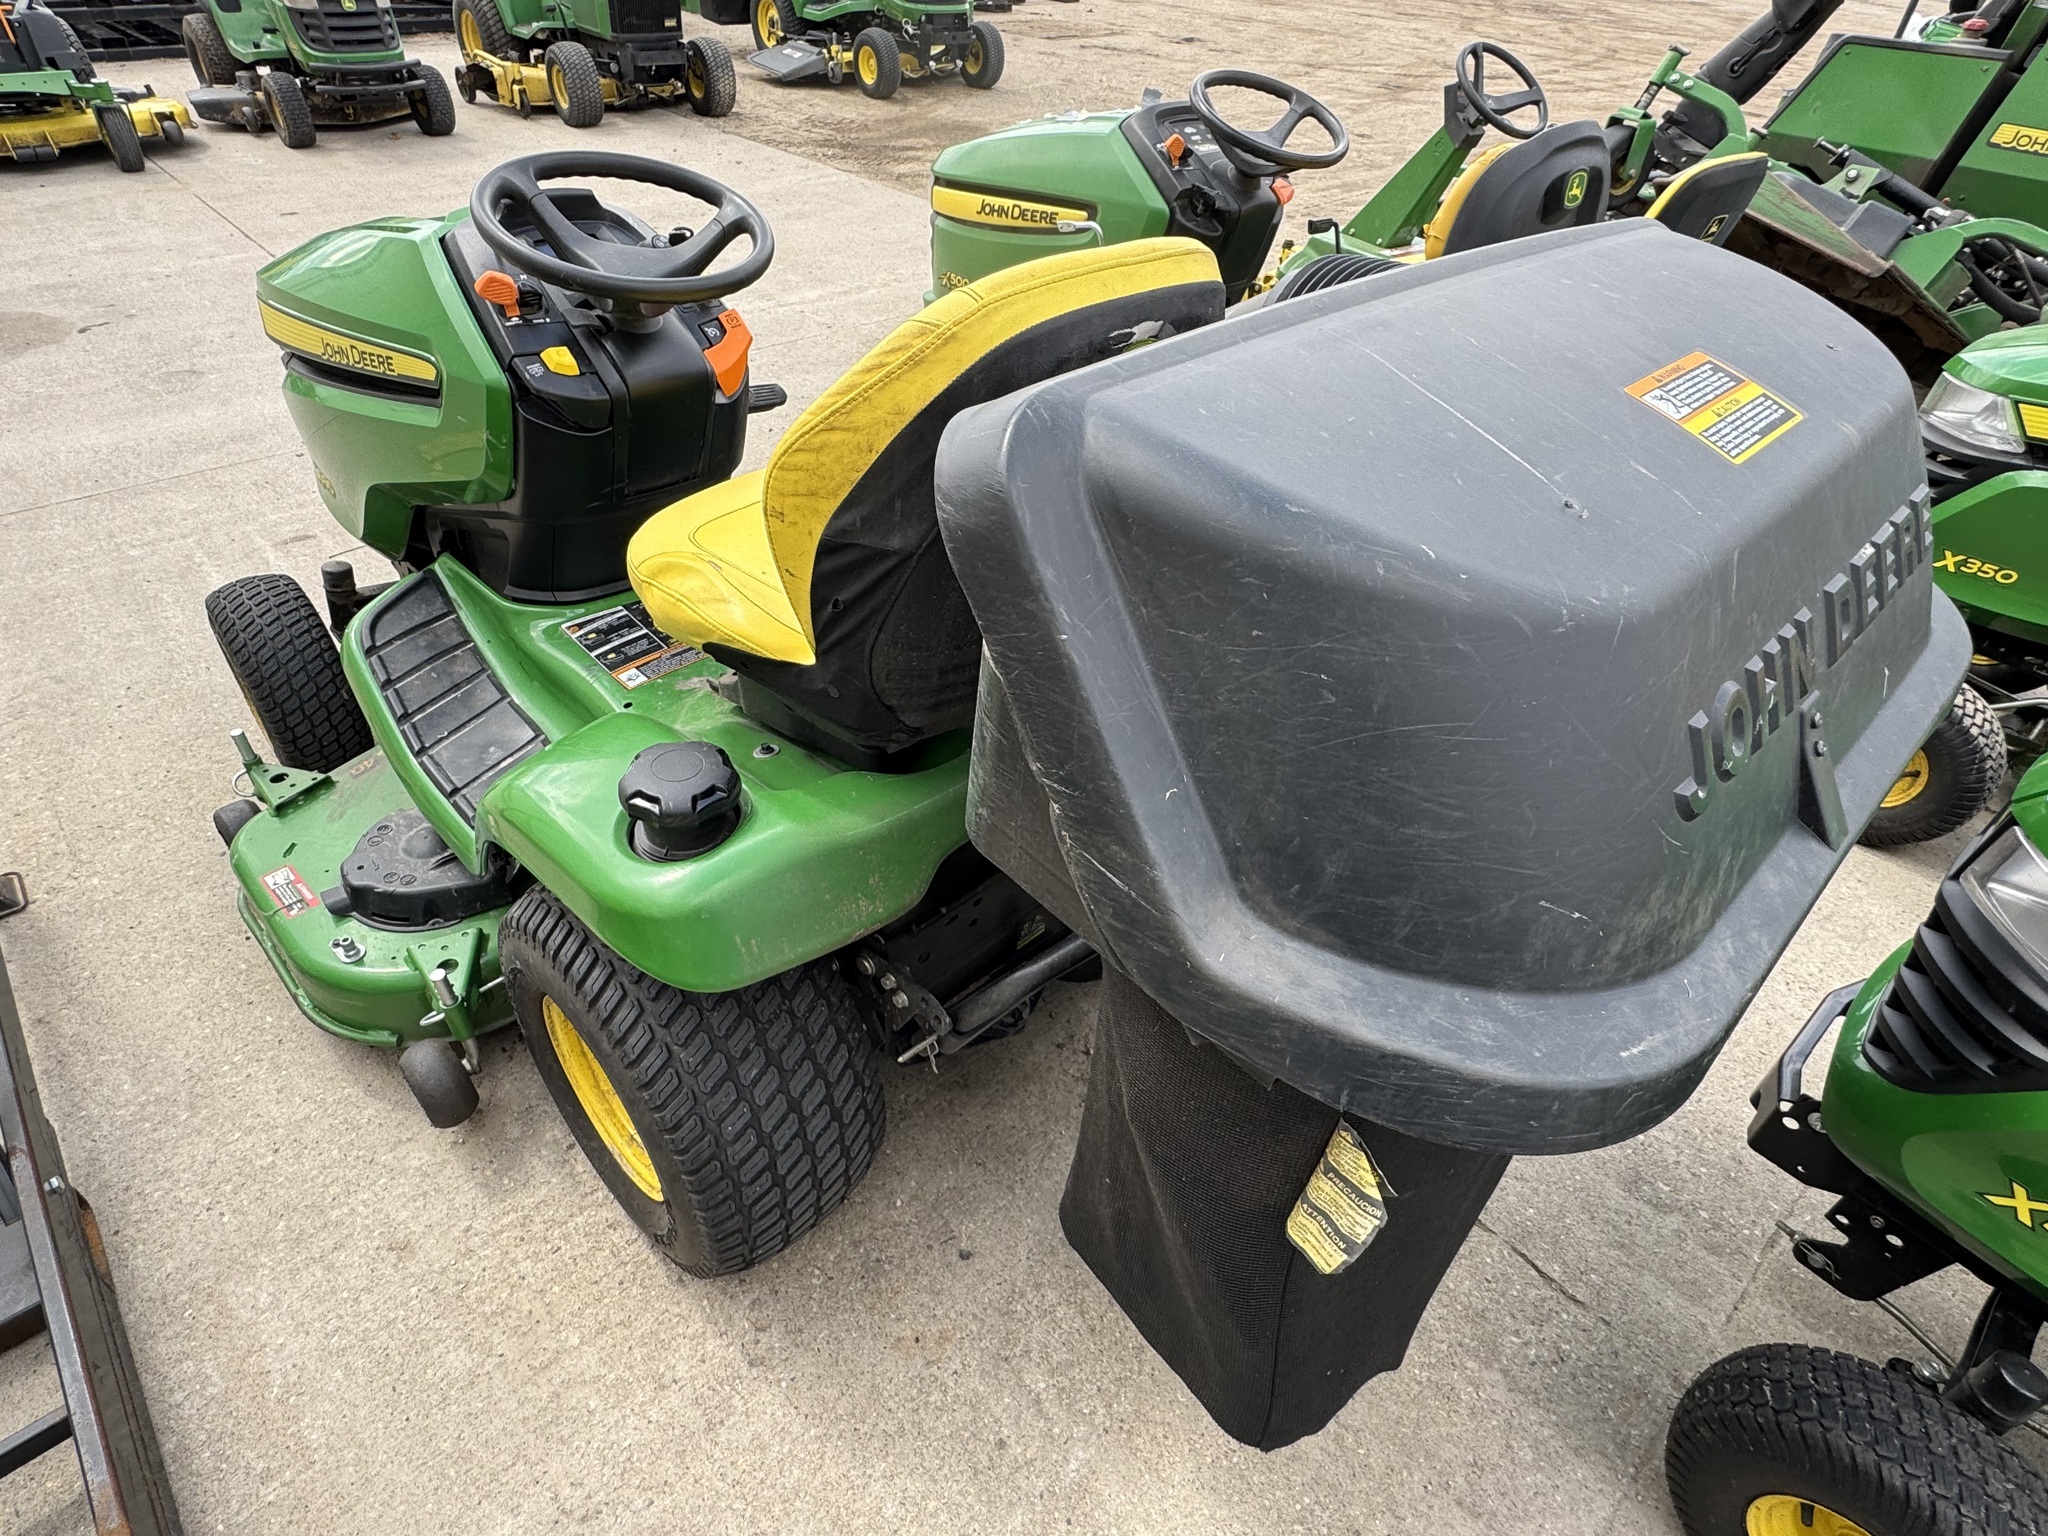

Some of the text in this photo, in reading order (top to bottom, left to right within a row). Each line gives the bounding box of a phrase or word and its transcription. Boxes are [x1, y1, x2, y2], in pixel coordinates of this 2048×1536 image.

[2002, 129, 2048, 152] JOH
[976, 199, 1060, 226] JOHN DEERE
[321, 338, 396, 374] JOHN DEERE
[1719, 397, 1743, 416] CAUTION
[1932, 549, 2019, 585] X350
[1673, 606, 1817, 822] JOHN
[1822, 483, 1933, 670] DEERE
[1326, 1171, 1383, 1219] PRECAUCION
[1301, 1203, 1347, 1249] ATTENTION
